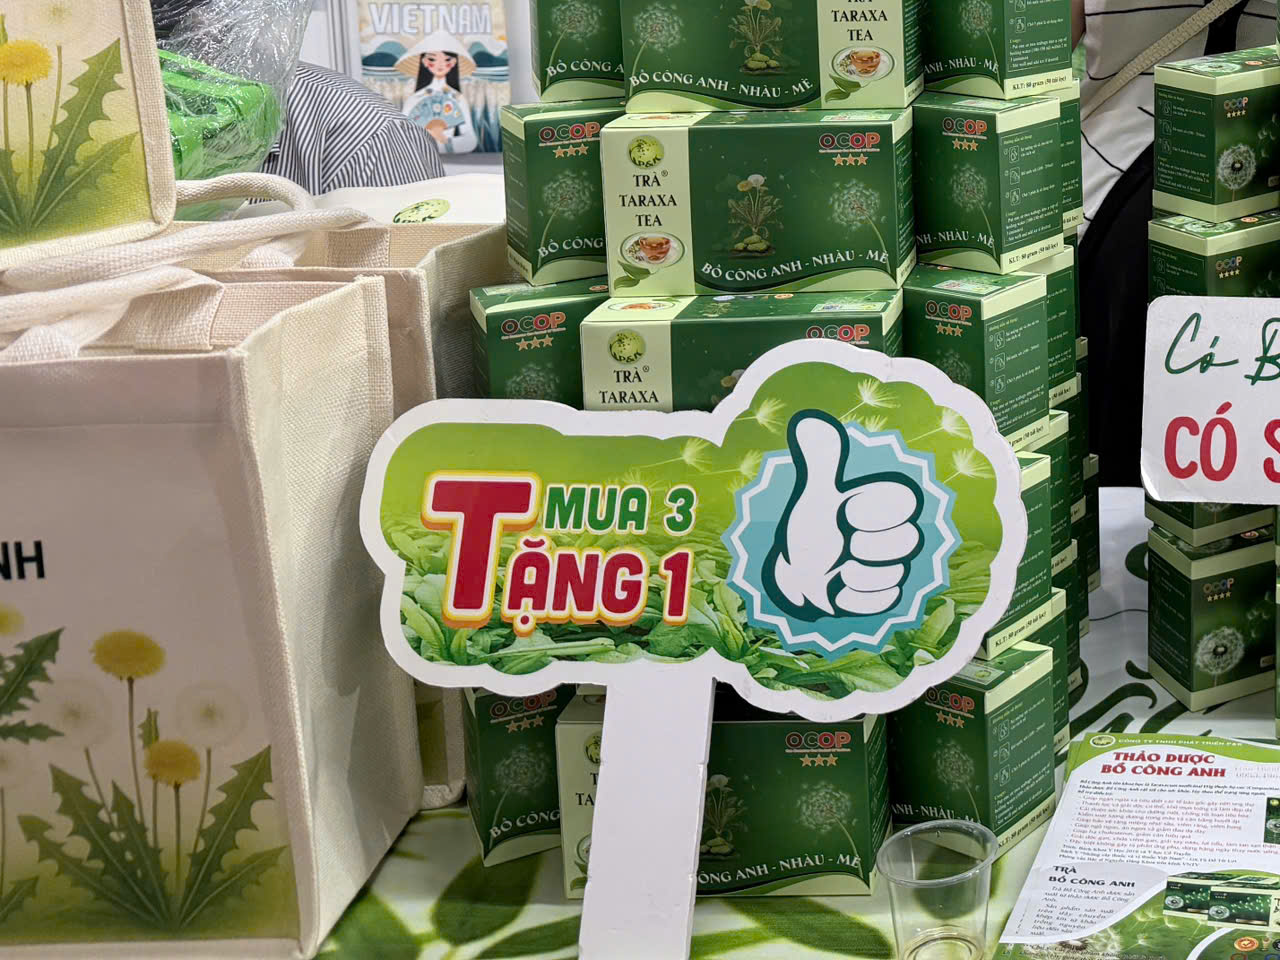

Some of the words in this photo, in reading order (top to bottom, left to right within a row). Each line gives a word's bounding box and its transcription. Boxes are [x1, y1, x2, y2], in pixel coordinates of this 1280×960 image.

[369, 2, 492, 35] VIETNAM
[832, 10, 888, 22] TARAXA
[847, 29, 873, 41] TEA
[653, 69, 693, 85] CÔNG
[696, 78, 728, 91] ANH
[738, 83, 781, 98] NHÀU
[1032, 80, 1044, 88] gram
[539, 122, 600, 142] OCOP
[943, 118, 987, 134] OCOP
[819, 132, 880, 149] OCOP
[633, 172, 661, 186] TRÀ
[619, 194, 677, 207] TARAXA
[635, 214, 662, 227] TEA
[725, 268, 767, 281] CÔNG
[770, 261, 802, 277] ANH
[812, 250, 854, 266] NHÀU
[926, 300, 973, 321] OCOP
[501, 312, 566, 334] OCOP
[806, 324, 870, 341] OCOP
[1164, 313, 1239, 376] Có
[613, 367, 642, 383] TRÀ
[599, 390, 658, 403] TARAXA
[1164, 402, 1238, 482] CÓ
[544, 486, 647, 531] MUA
[666, 486, 694, 532] 3
[431, 479, 645, 630] TẶNG
[663, 552, 688, 621] 1
[785, 732, 851, 749] OCOP
[1113, 750, 1161, 762] THẢO
[1166, 754, 1215, 765] DƯỢC
[1131, 764, 1183, 776] CÔNG
[1186, 768, 1226, 777] ANH
[1052, 865, 1077, 874] TRÀ
[1070, 878, 1105, 886] CÔNG
